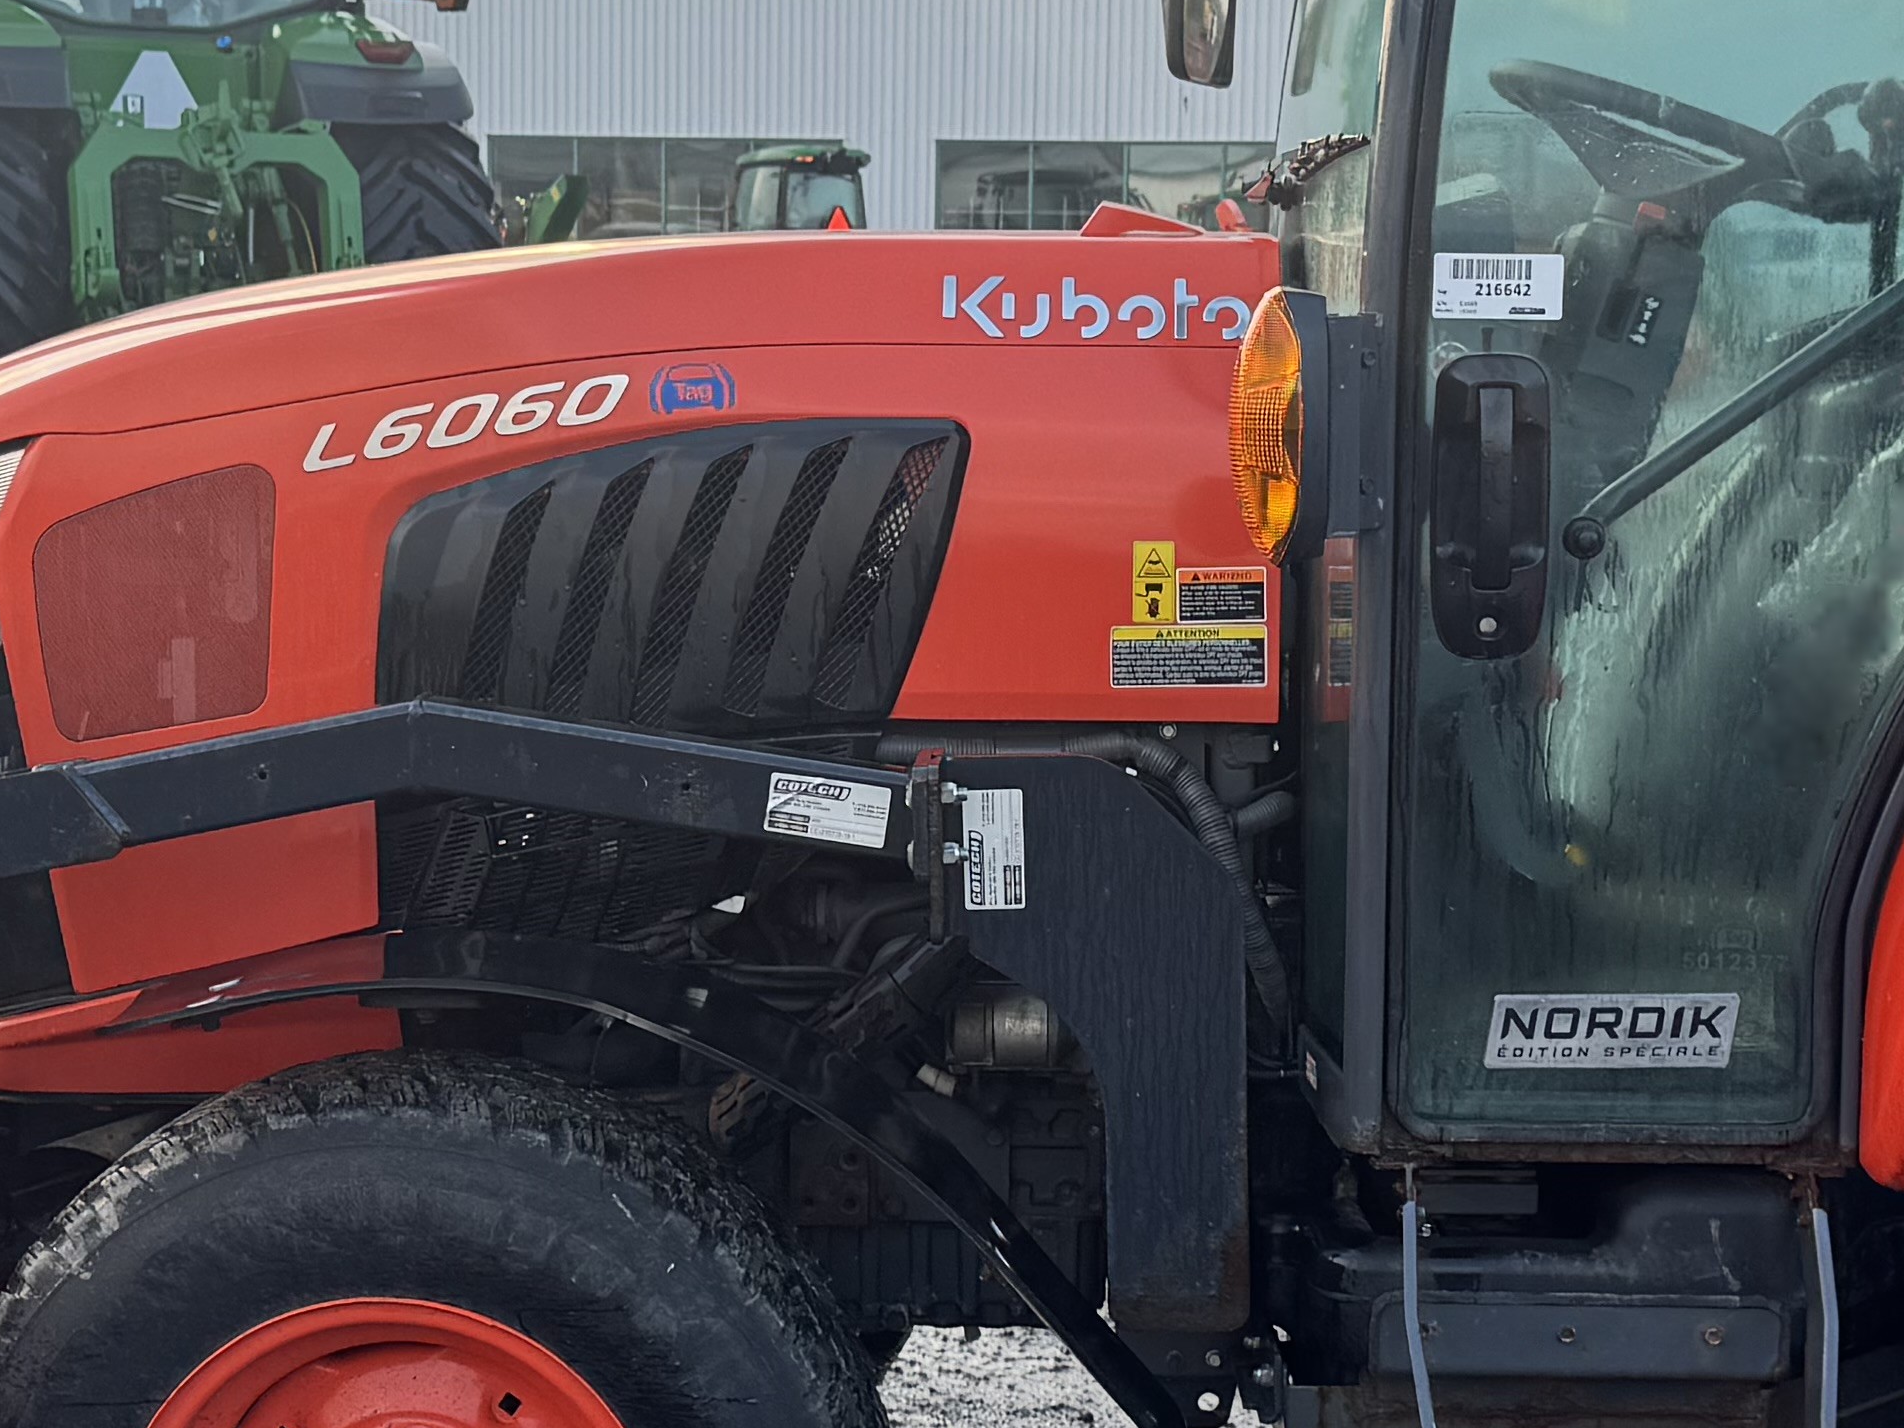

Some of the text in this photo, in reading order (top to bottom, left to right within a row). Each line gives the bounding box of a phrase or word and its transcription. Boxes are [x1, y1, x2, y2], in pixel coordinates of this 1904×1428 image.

[1475, 283, 1532, 297] 216642
[941, 275, 1251, 341] Kubota
[302, 373, 630, 472] L6060
[1166, 628, 1220, 638] ATTENTION
[970, 840, 982, 904] COTECH
[1500, 1005, 1727, 1040] NORDIK
[1497, 1043, 1721, 1058] ÉDITION SPÉCIALE
